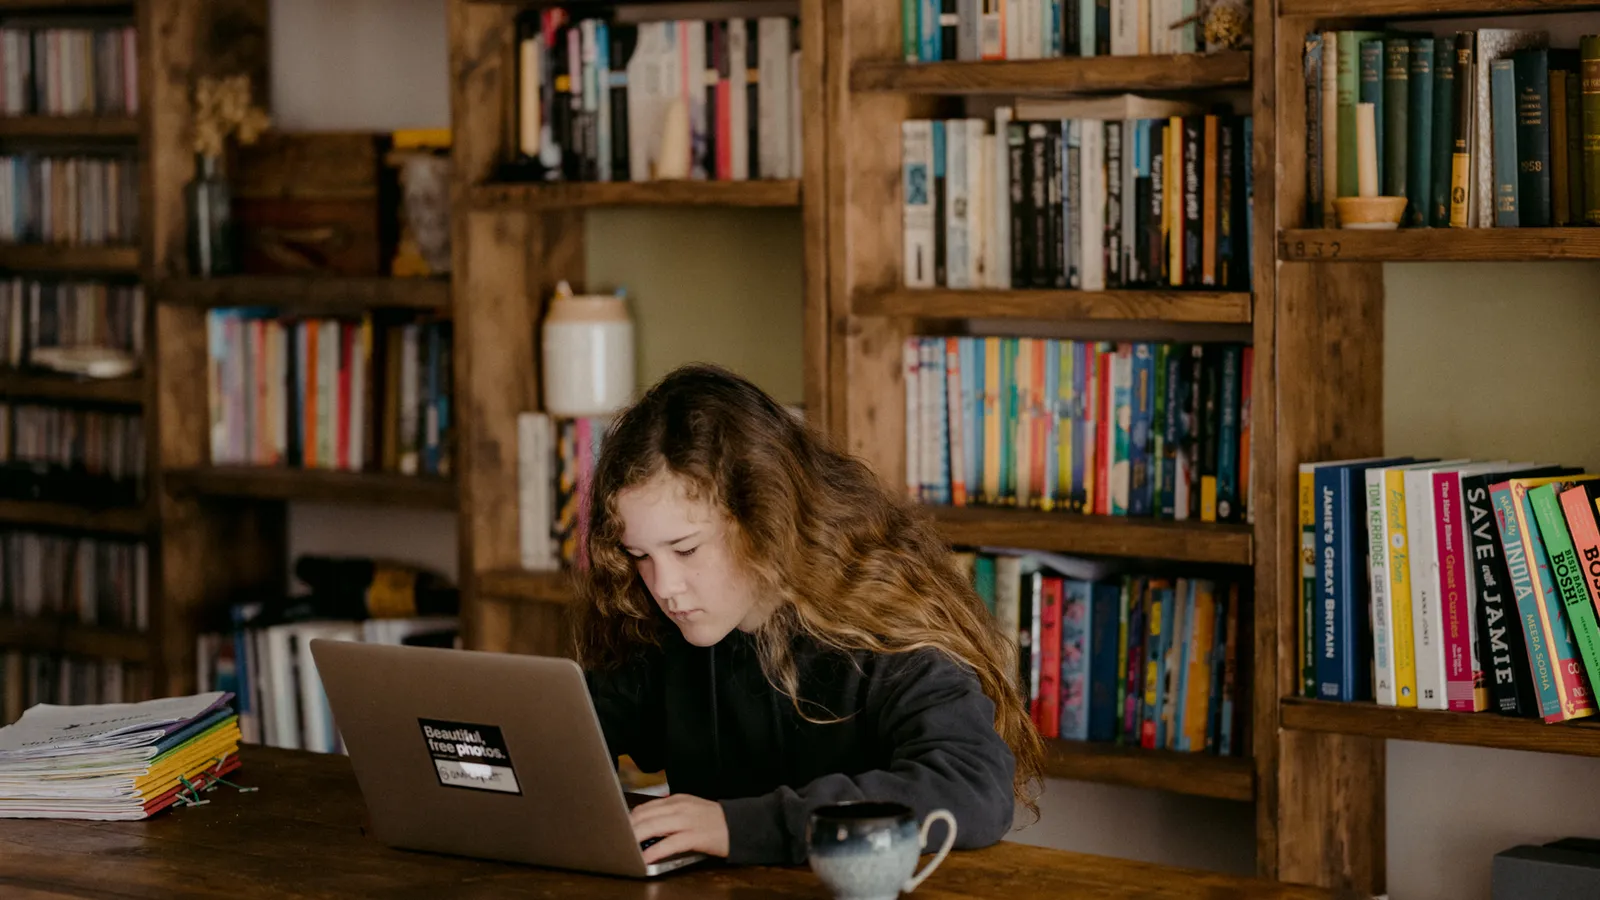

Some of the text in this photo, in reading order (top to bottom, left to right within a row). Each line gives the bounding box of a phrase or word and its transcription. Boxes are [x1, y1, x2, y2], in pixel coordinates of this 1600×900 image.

[1521, 161, 1542, 172] 1958
[1368, 483, 1380, 507] TOM
[1500, 496, 1516, 536] MADE IN
[1370, 510, 1384, 568] KERRIDGE
[1467, 487, 1495, 560] SAVE
[1323, 485, 1335, 658] JAMIE'S GREAT BRITAIN
[1375, 575, 1383, 594] LOSE
[1446, 554, 1456, 589] Great
[1482, 565, 1496, 586] with
[1504, 540, 1533, 601] INDIA
[1552, 552, 1579, 606] BOSH!
[1565, 549, 1587, 602] BISH BASH
[1584, 545, 1600, 600] BO
[1376, 596, 1385, 626] WEIGHT
[1448, 591, 1459, 639] Curries
[1483, 590, 1513, 684] JAMIE
[1526, 614, 1550, 691] MEERA SODHA
[428, 739, 506, 759] free photos.
